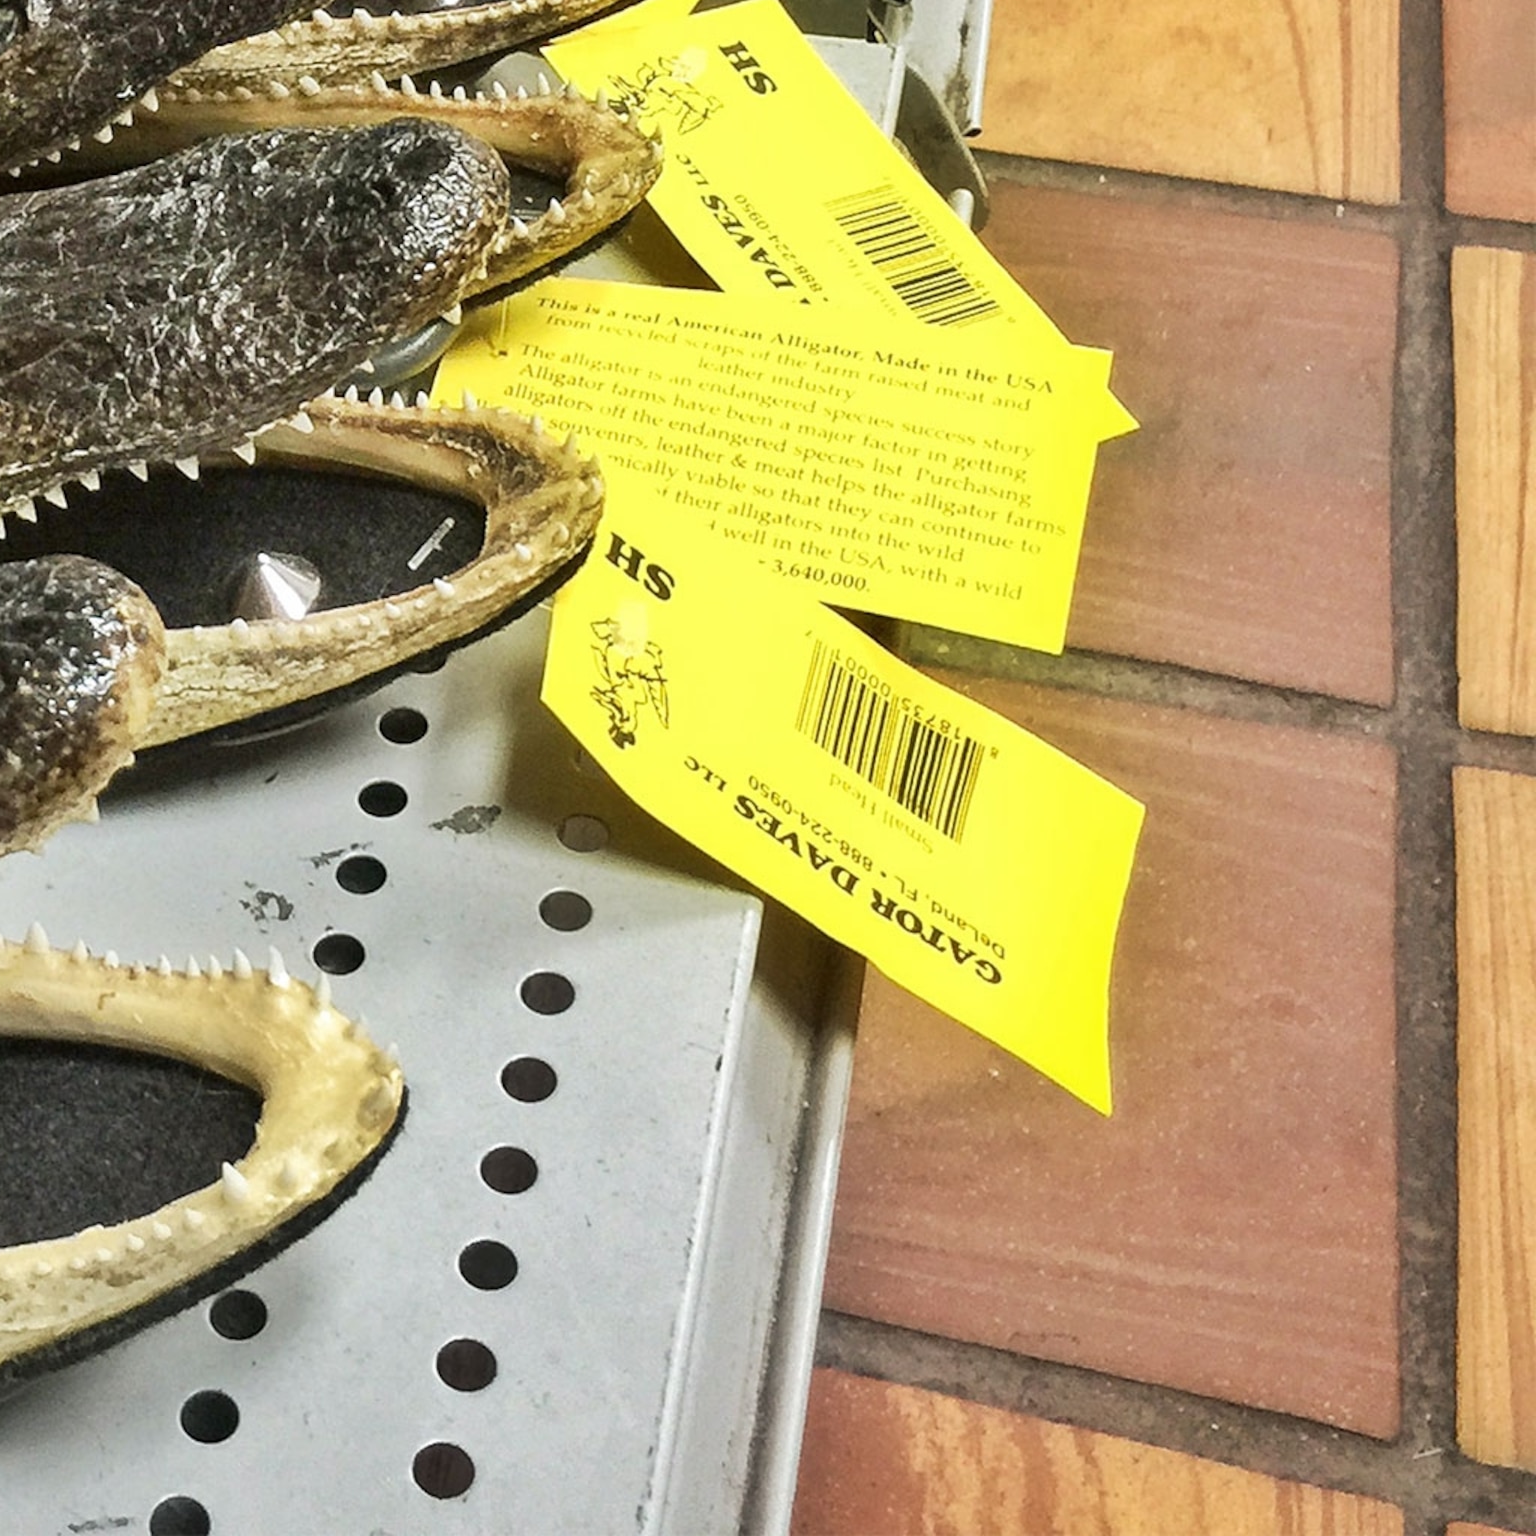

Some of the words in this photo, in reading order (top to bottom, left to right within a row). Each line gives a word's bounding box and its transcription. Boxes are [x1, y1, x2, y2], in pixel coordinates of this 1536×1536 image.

[717, 39, 778, 95] SH
[674, 153, 710, 186] LLC
[699, 193, 797, 289] DAVES
[732, 193, 823, 293] 888-224-0950
[535, 295, 578, 311] This
[583, 302, 601, 315] is
[623, 311, 661, 324] real
[666, 315, 763, 341] American
[872, 349, 931, 371] Made
[937, 365, 958, 377] in
[964, 367, 998, 384] the
[1005, 372, 1053, 394] USA
[697, 355, 765, 381] leather
[776, 352, 807, 369] the
[867, 371, 928, 393] raised
[934, 385, 985, 404] meat
[991, 395, 1031, 412] and
[517, 362, 605, 392] Alligator
[610, 380, 666, 404] farms
[672, 392, 721, 416] have
[725, 404, 773, 427] been
[796, 423, 856, 444] major
[861, 433, 921, 457] factor
[951, 455, 1027, 484] getting
[520, 342, 556, 361] The
[558, 351, 641, 377] alligator
[697, 380, 817, 414] endangered
[822, 406, 895, 429] species
[900, 421, 976, 446] success
[502, 382, 593, 412] alligators
[631, 407, 664, 427] the
[667, 419, 787, 453] endangered
[792, 445, 865, 469] species
[914, 465, 1032, 509] Purchasing
[655, 435, 725, 464] leather
[729, 452, 748, 469] &
[753, 460, 805, 481] meat
[810, 467, 866, 496] helps
[872, 481, 905, 501] the
[910, 491, 998, 521] alligator
[1005, 509, 1066, 537] farms
[685, 469, 747, 493] viable
[751, 484, 775, 499] so
[780, 486, 821, 509] that
[826, 496, 872, 523] they
[877, 511, 915, 528] can
[920, 520, 1014, 549] continue
[1020, 538, 1042, 554] to
[674, 488, 722, 512] their
[726, 500, 823, 533] alligators
[829, 524, 871, 542] into
[876, 531, 911, 551] the
[917, 542, 965, 563] wild
[603, 530, 676, 601] SH
[722, 526, 767, 545] well
[771, 536, 792, 551] in
[799, 539, 832, 560] the
[838, 546, 893, 574] USA,
[900, 563, 947, 584] with
[974, 579, 1023, 601] wild
[771, 558, 870, 592] 3,640,000.
[900, 696, 961, 740] 18735
[683, 754, 727, 792] LLC
[828, 771, 877, 816] Head
[732, 793, 860, 896] DAVES
[747, 774, 873, 872] 888-224-0950
[881, 808, 934, 855] Small
[893, 874, 918, 903] FL
[869, 887, 1002, 985] GATOR
[924, 893, 1005, 960] DeLand,
